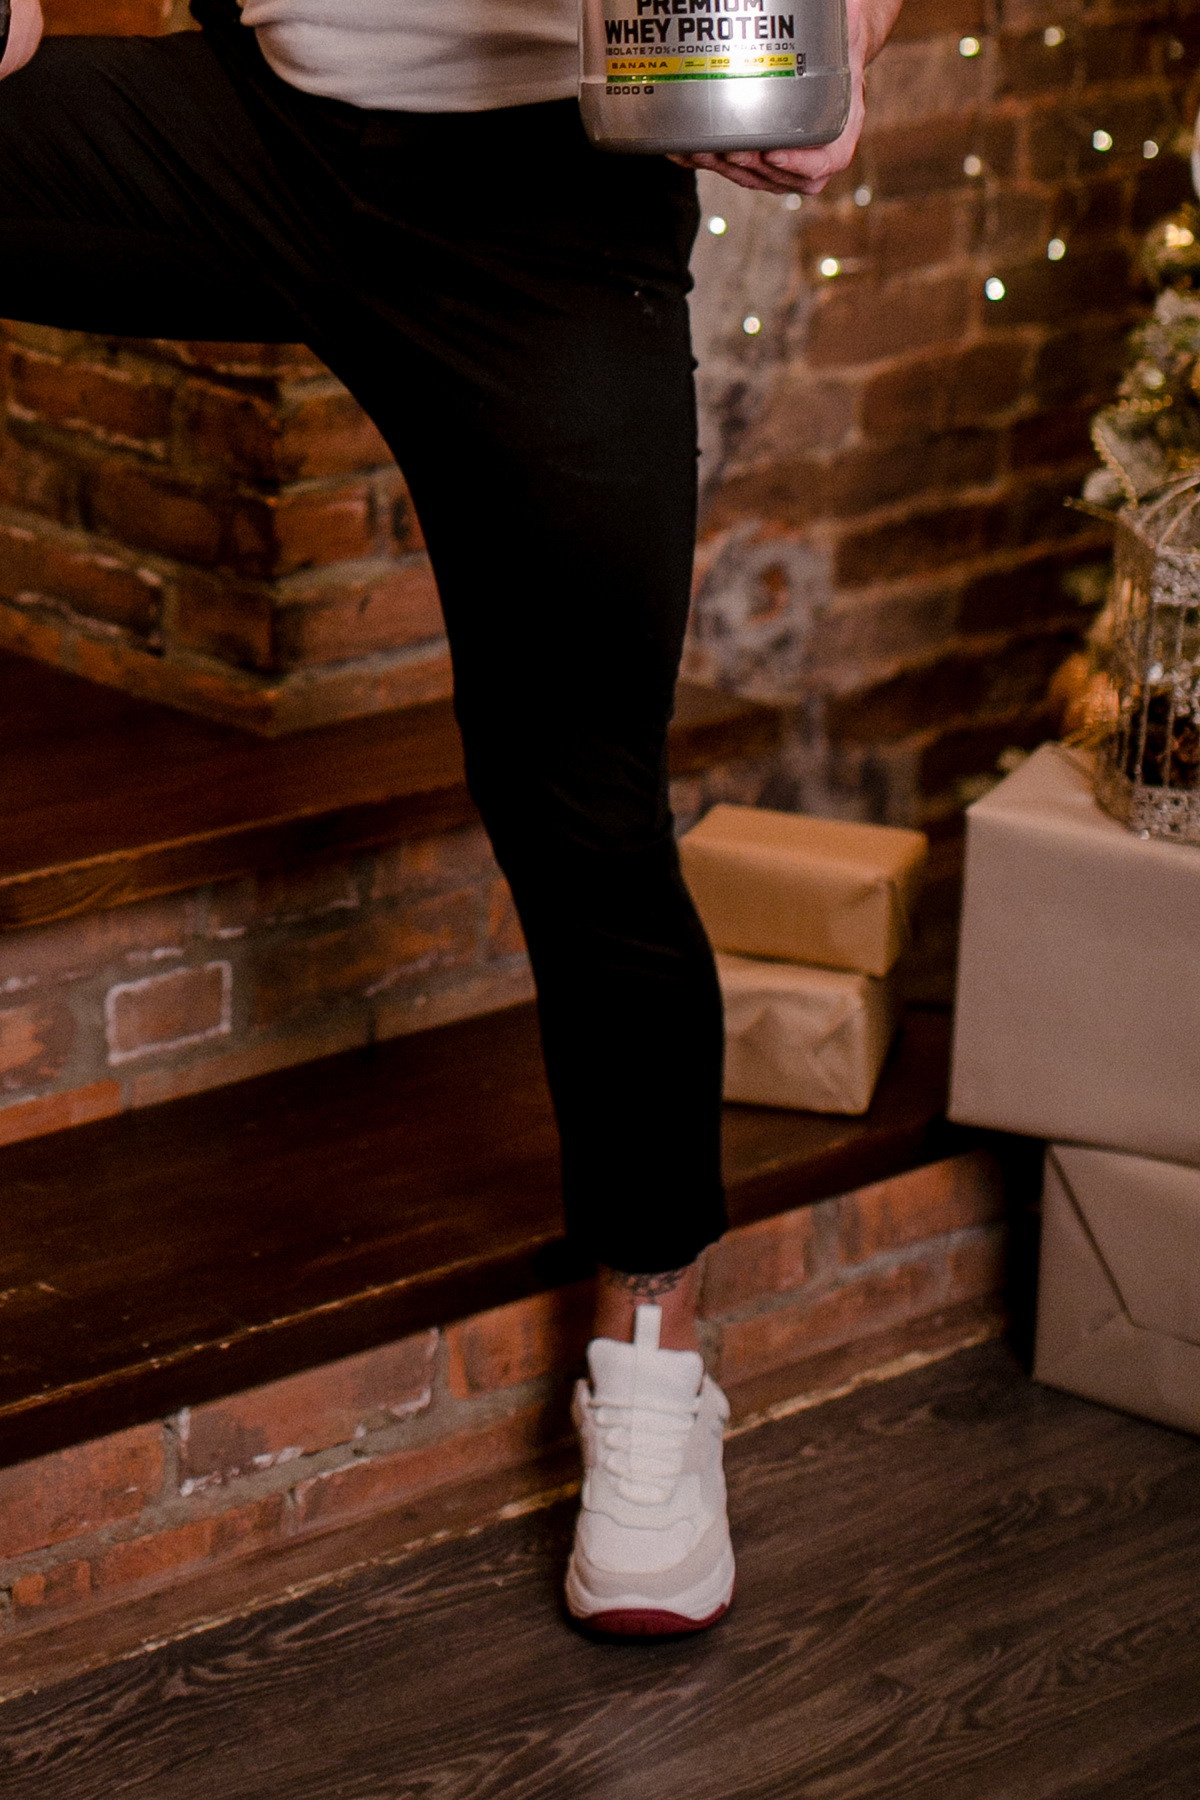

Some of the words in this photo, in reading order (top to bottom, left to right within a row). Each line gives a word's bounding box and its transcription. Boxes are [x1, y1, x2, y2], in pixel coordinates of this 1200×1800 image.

[604, 17, 671, 44] WHEY
[678, 14, 795, 42] PROTEIN
[605, 46, 646, 56] ISOLATE
[774, 41, 796, 51] 30%
[611, 60, 669, 70] BANANA
[606, 85, 640, 95] 2000
[644, 85, 654, 95] G
